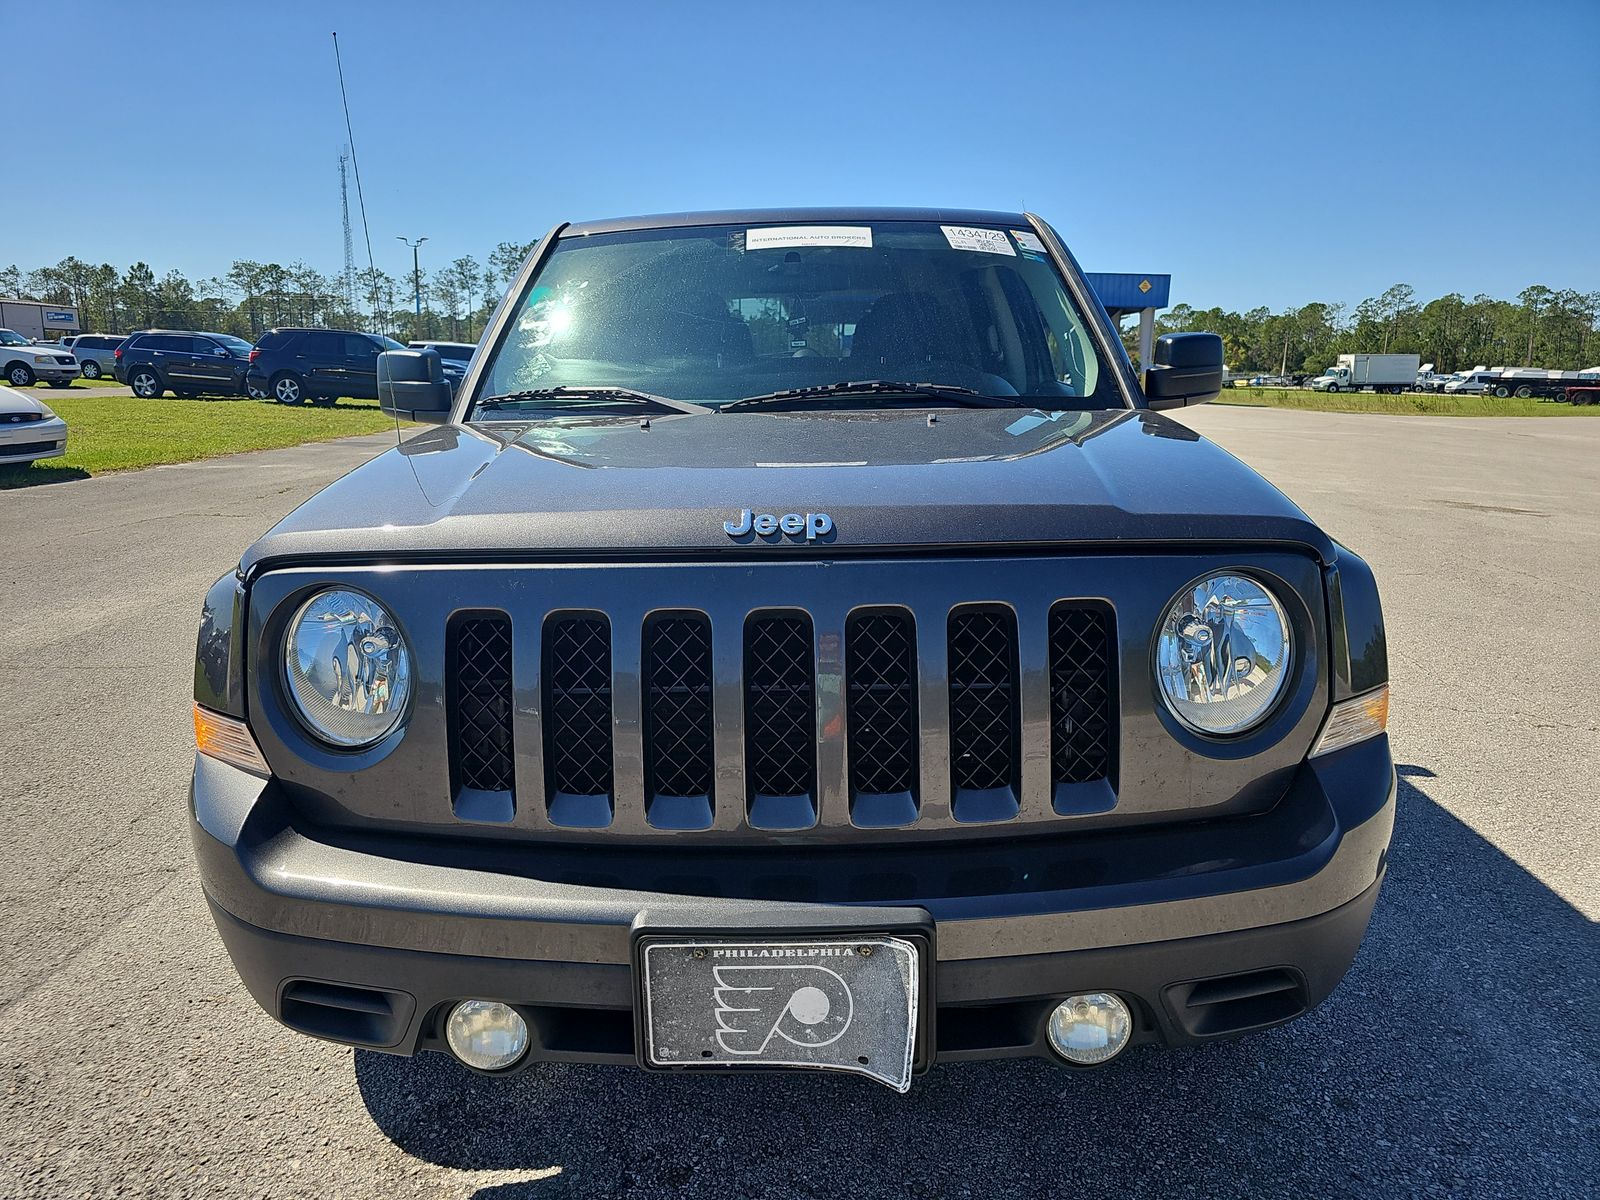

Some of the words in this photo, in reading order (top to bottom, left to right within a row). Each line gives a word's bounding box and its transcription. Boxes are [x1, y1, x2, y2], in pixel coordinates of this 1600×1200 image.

[751, 235, 808, 243] INTERNATIONAL
[950, 228, 1006, 242] 1434729
[723, 508, 833, 540] Jeep
[712, 948, 854, 958] PHILADELPHIA
